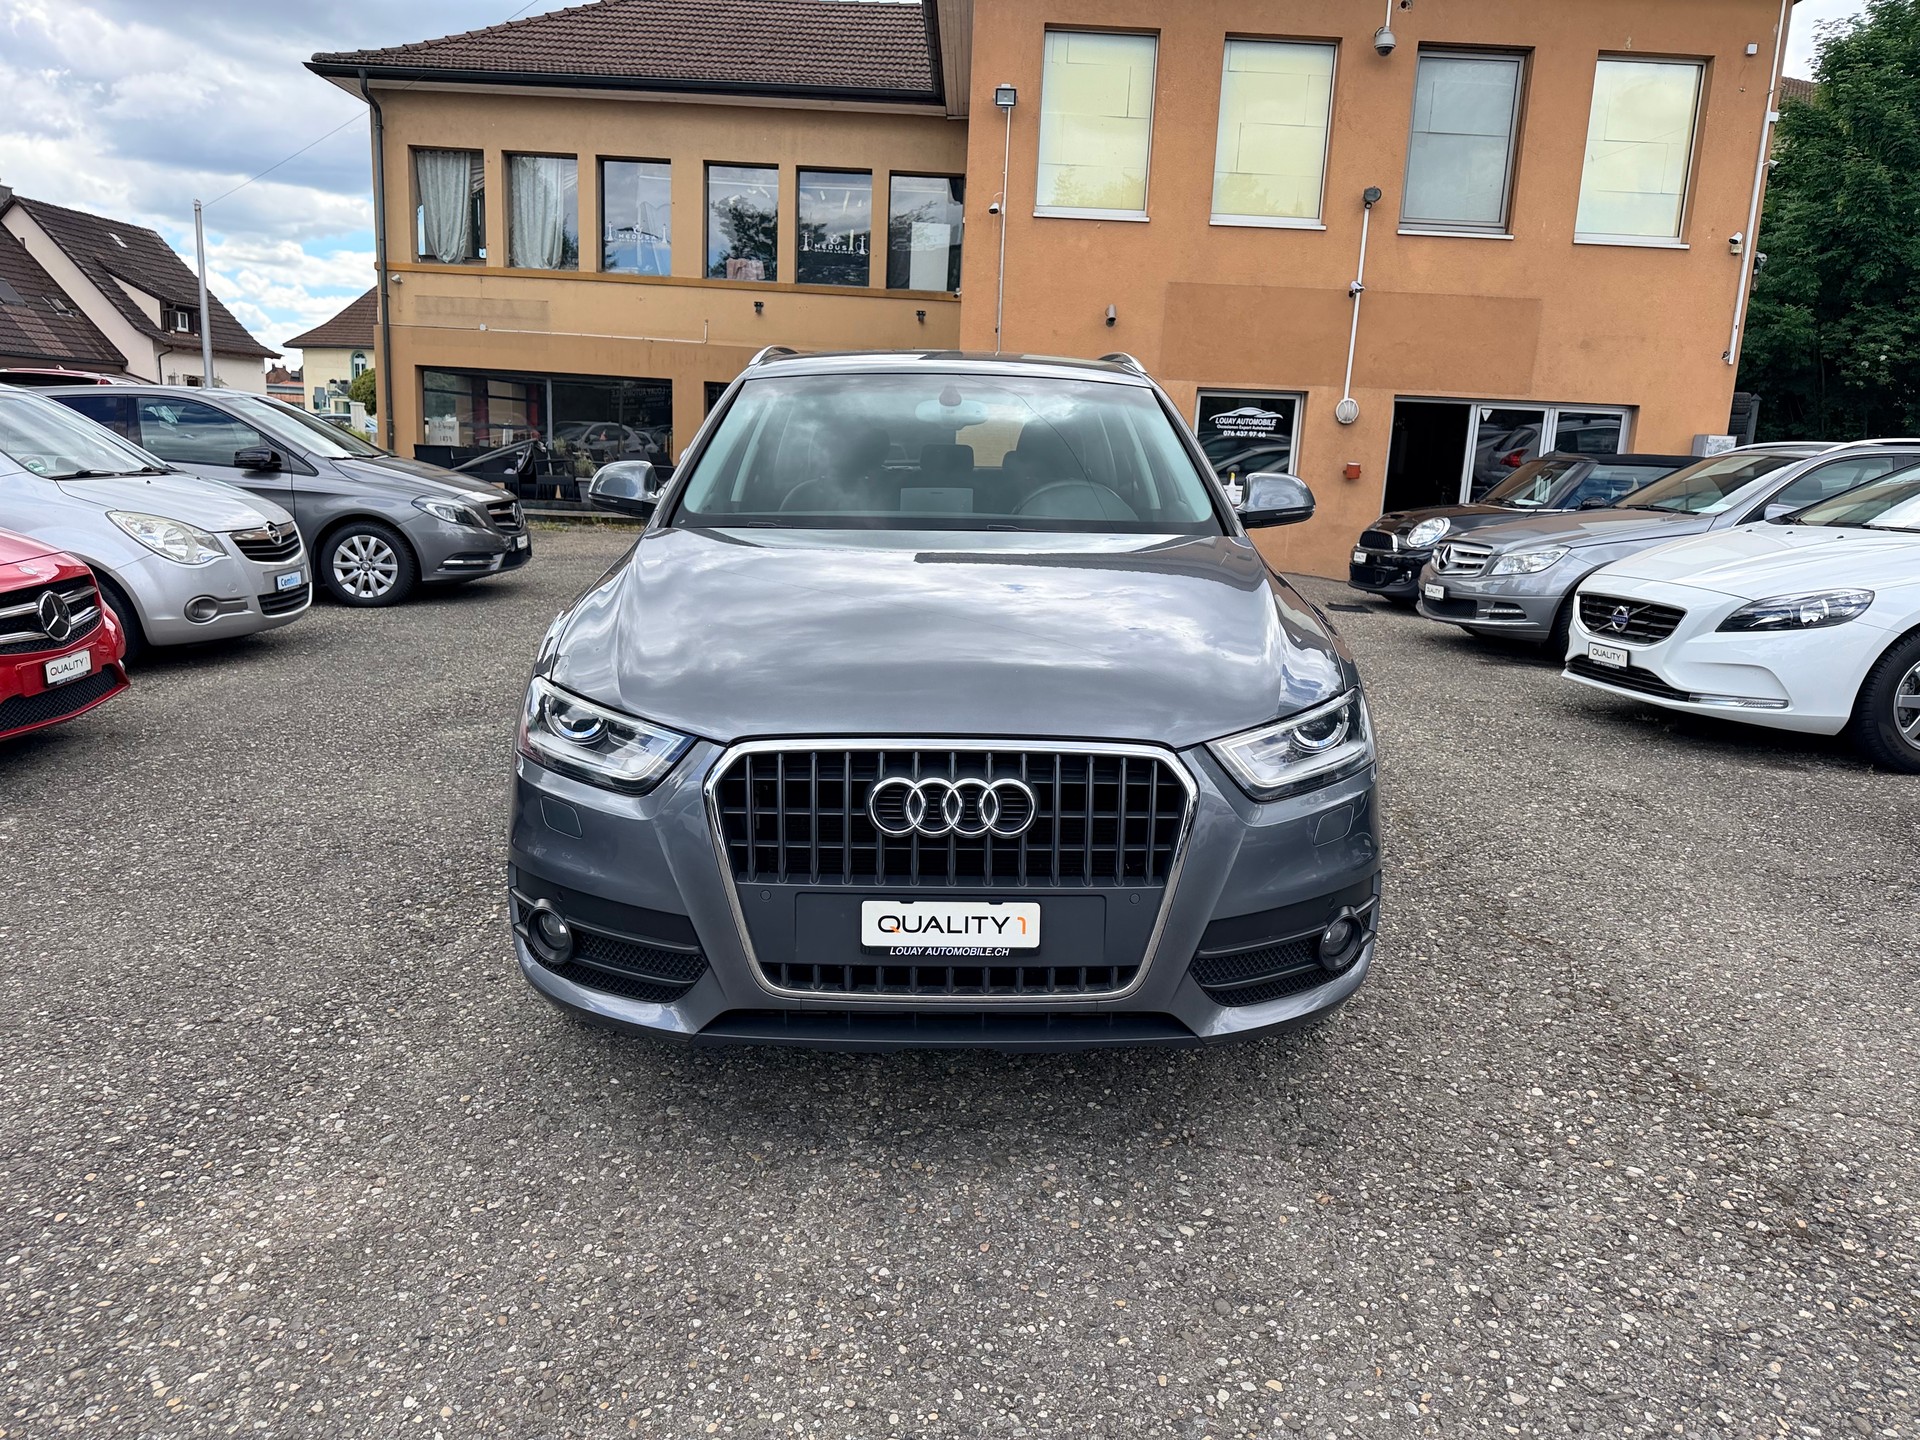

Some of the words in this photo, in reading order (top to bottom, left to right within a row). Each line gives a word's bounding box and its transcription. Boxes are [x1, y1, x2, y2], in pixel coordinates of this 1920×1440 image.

[1236, 418, 1277, 426] AUTOMOBILE
[1592, 648, 1621, 661] QUALITY
[50, 657, 85, 677] QUALITY
[878, 915, 1011, 934] QUALITY
[1017, 916, 1027, 935] 1
[890, 946, 924, 956] LOUAY
[925, 946, 1010, 957] AUTOMOBILE.CH
